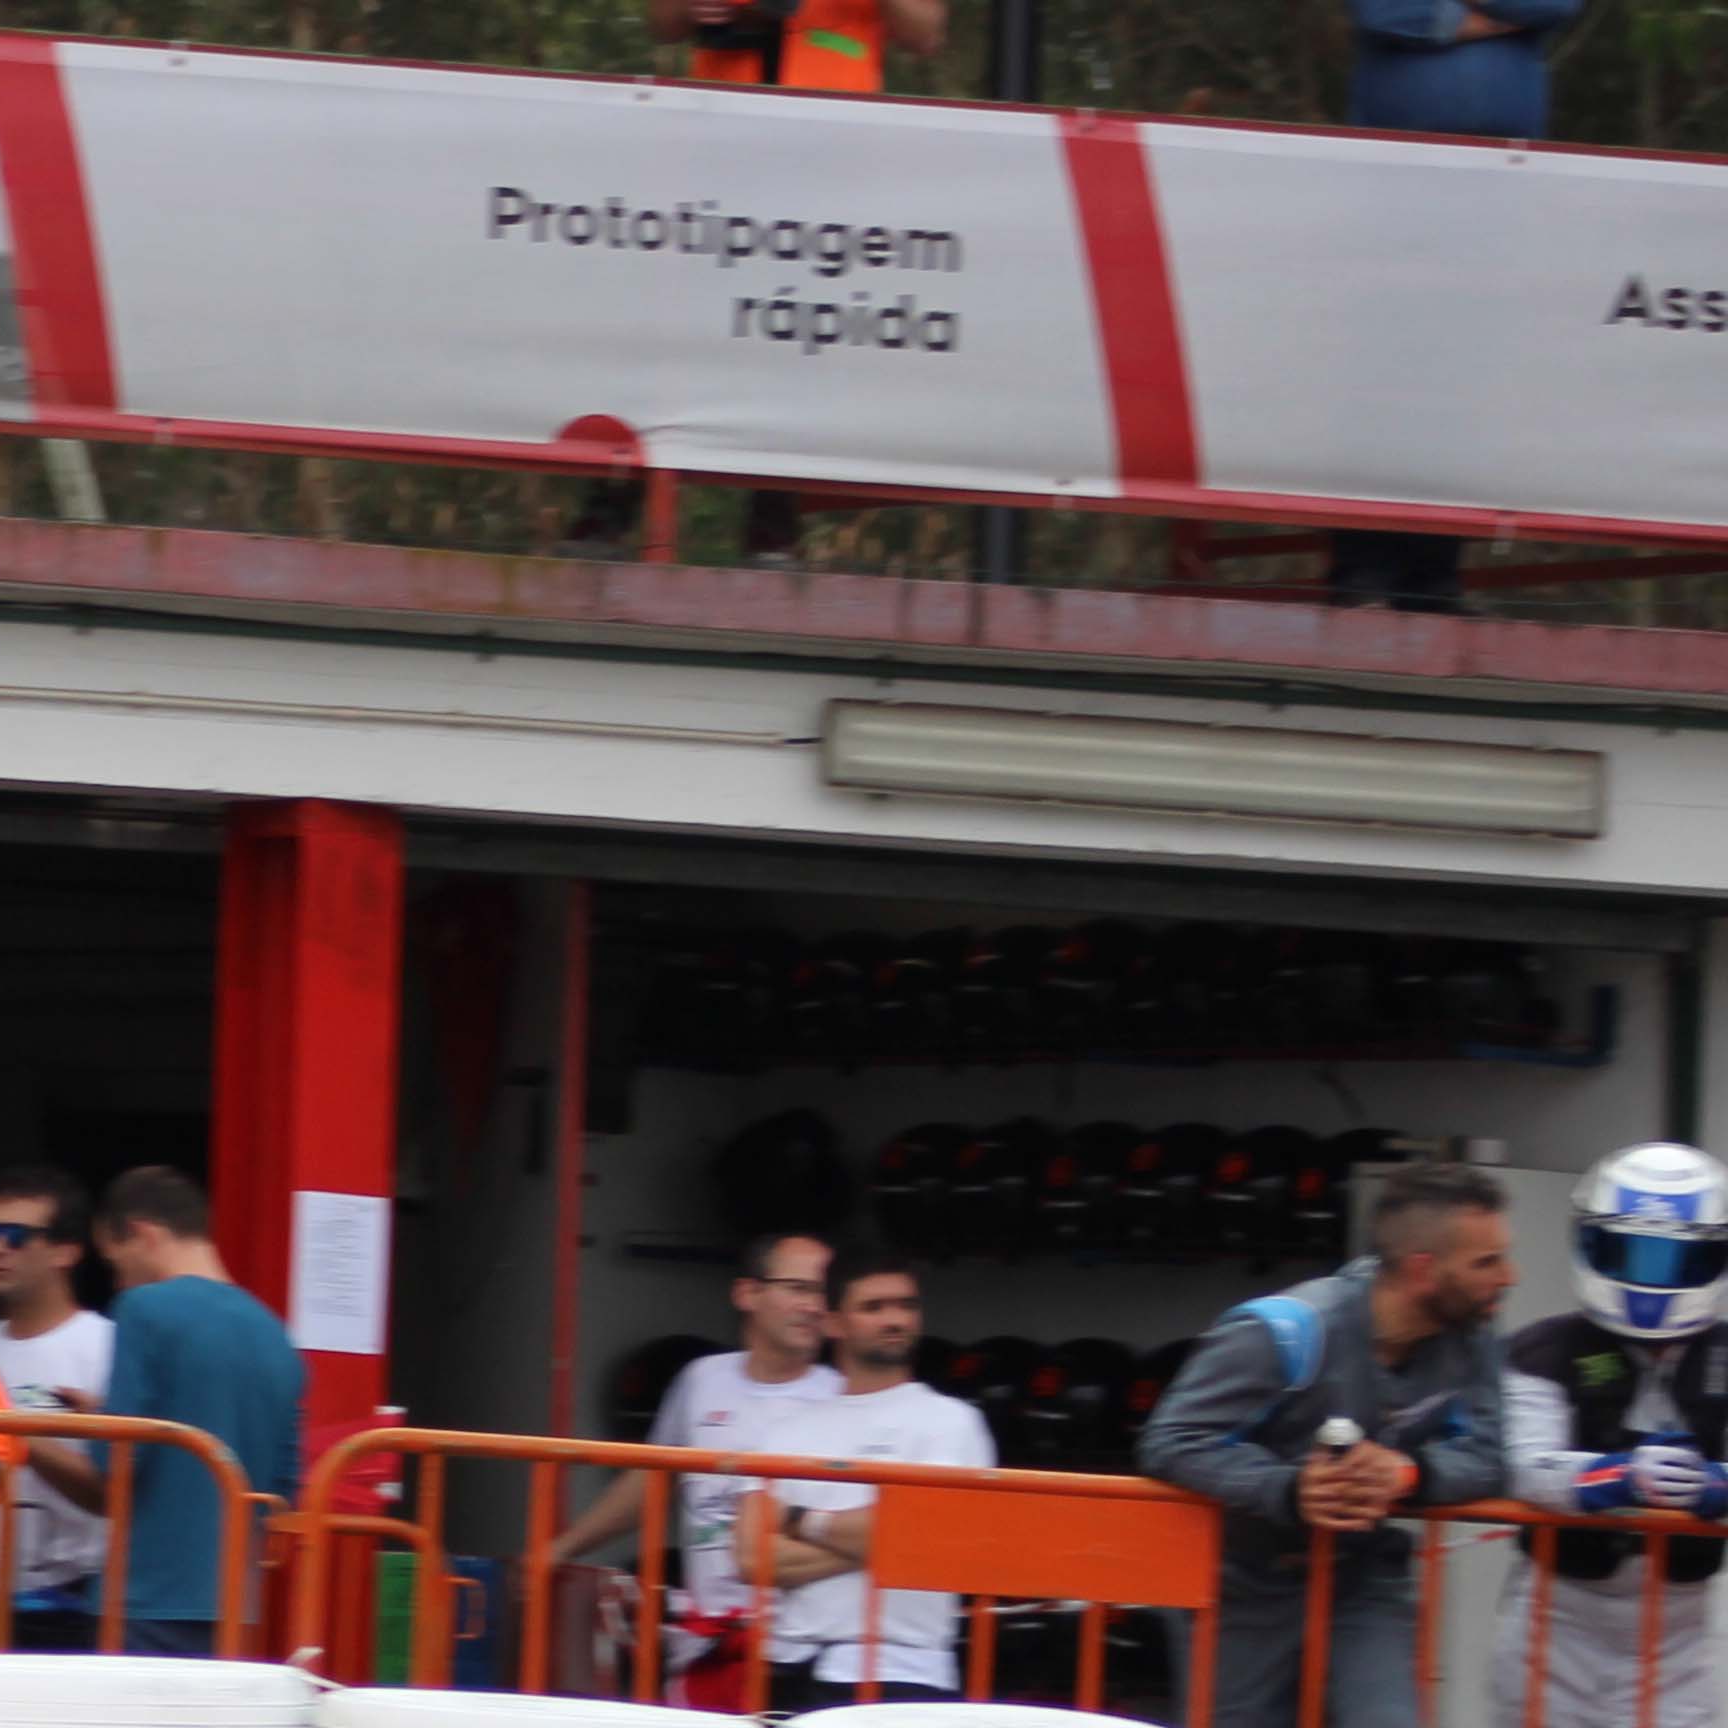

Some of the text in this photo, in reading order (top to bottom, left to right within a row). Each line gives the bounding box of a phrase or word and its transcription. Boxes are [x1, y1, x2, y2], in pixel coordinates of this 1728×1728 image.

[487, 185, 964, 280] Prototipagem
[732, 288, 962, 356] rápida
[1602, 273, 1728, 333] Ass
